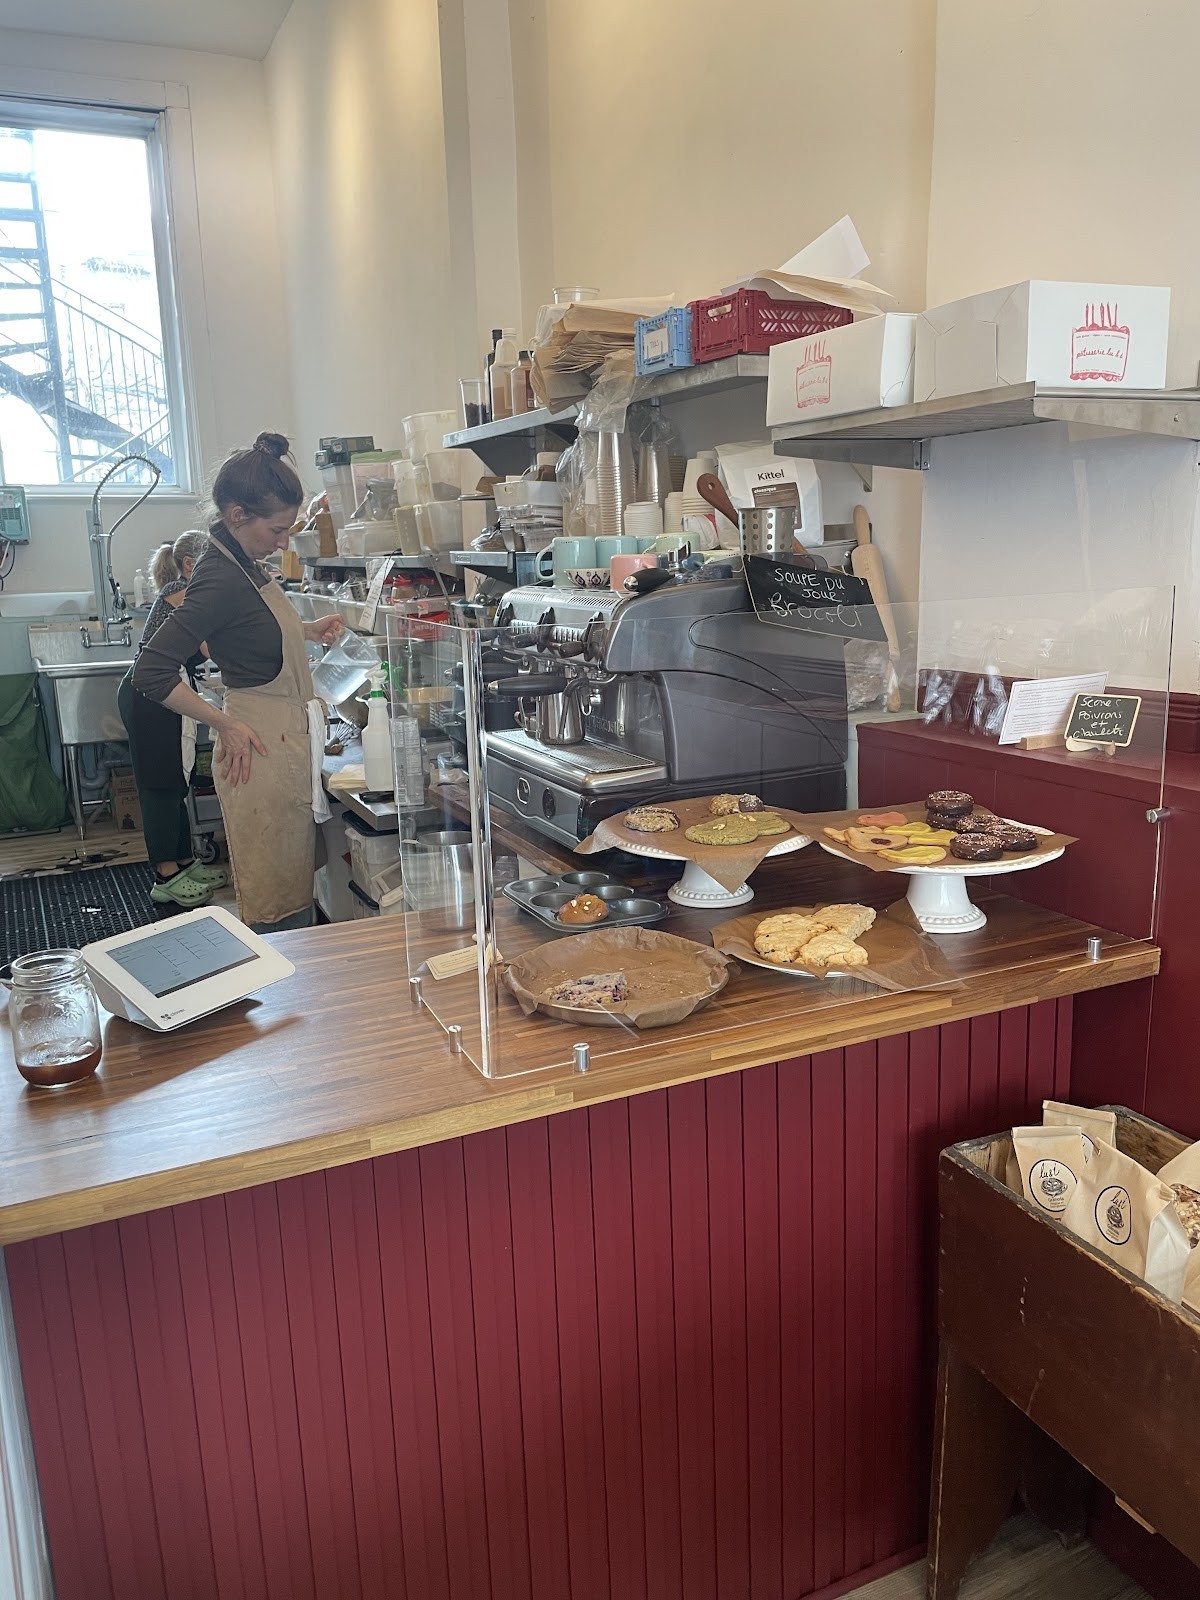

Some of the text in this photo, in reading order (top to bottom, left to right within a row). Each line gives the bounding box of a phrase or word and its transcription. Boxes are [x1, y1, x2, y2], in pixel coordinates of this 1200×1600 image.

[757, 469, 785, 481] Kittel
[774, 567, 846, 591] SOUPE DU
[1090, 720, 1109, 729] et
